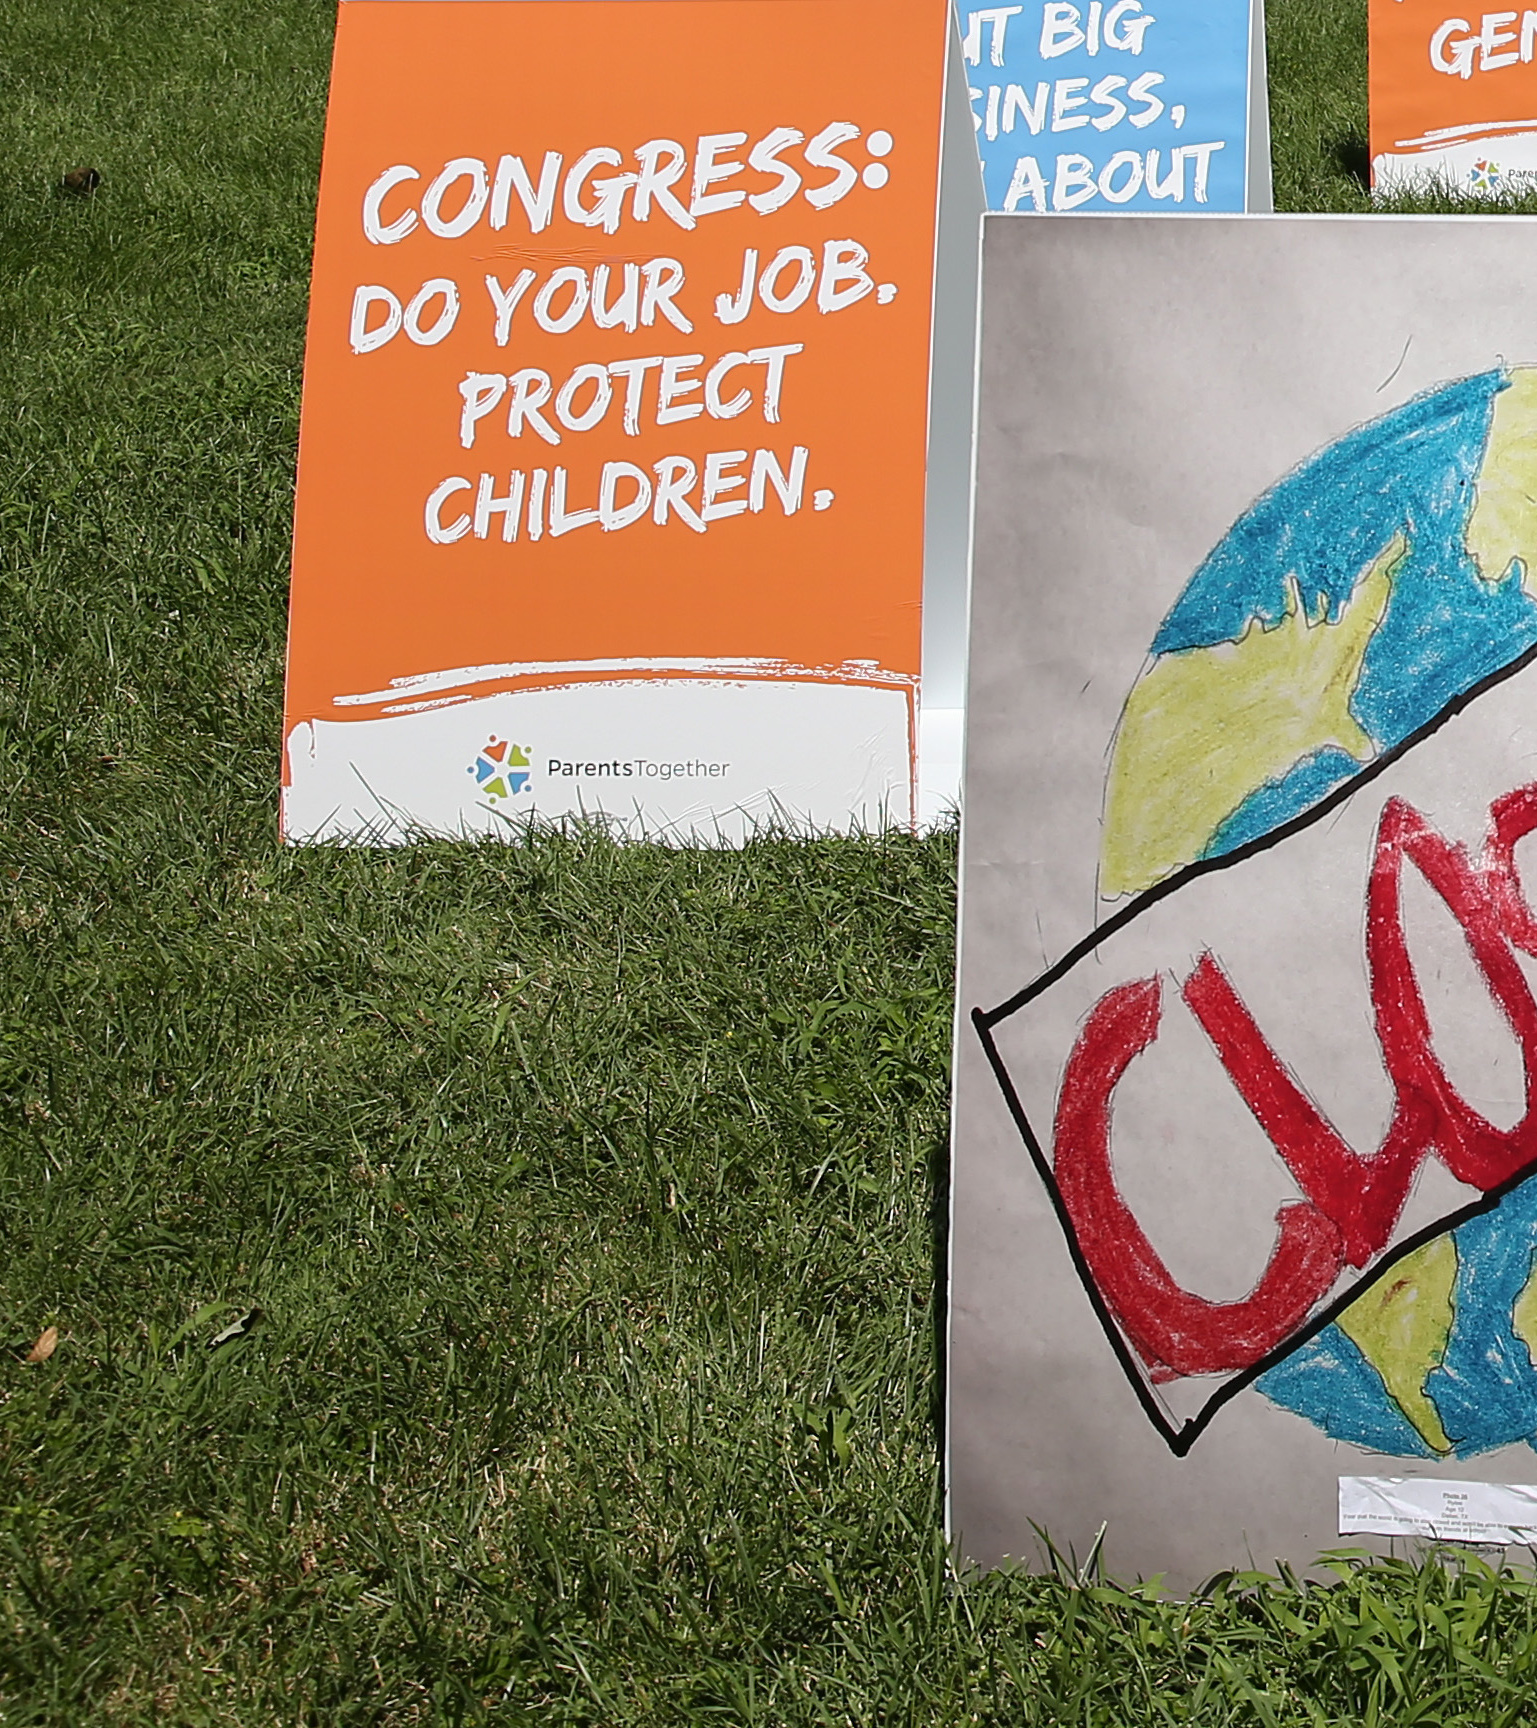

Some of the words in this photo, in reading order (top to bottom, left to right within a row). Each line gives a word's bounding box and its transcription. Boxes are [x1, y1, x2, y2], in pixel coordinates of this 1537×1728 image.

[361, 121, 895, 245] CONGRESS:
[1003, 141, 1226, 213] ABOUT
[349, 276, 460, 355] DO
[485, 256, 694, 346] YOUR
[713, 238, 898, 326] JOB.
[459, 343, 805, 449] PROTECT
[424, 445, 836, 545] CHILDREN.
[548, 759, 731, 781] ParentsTogether
